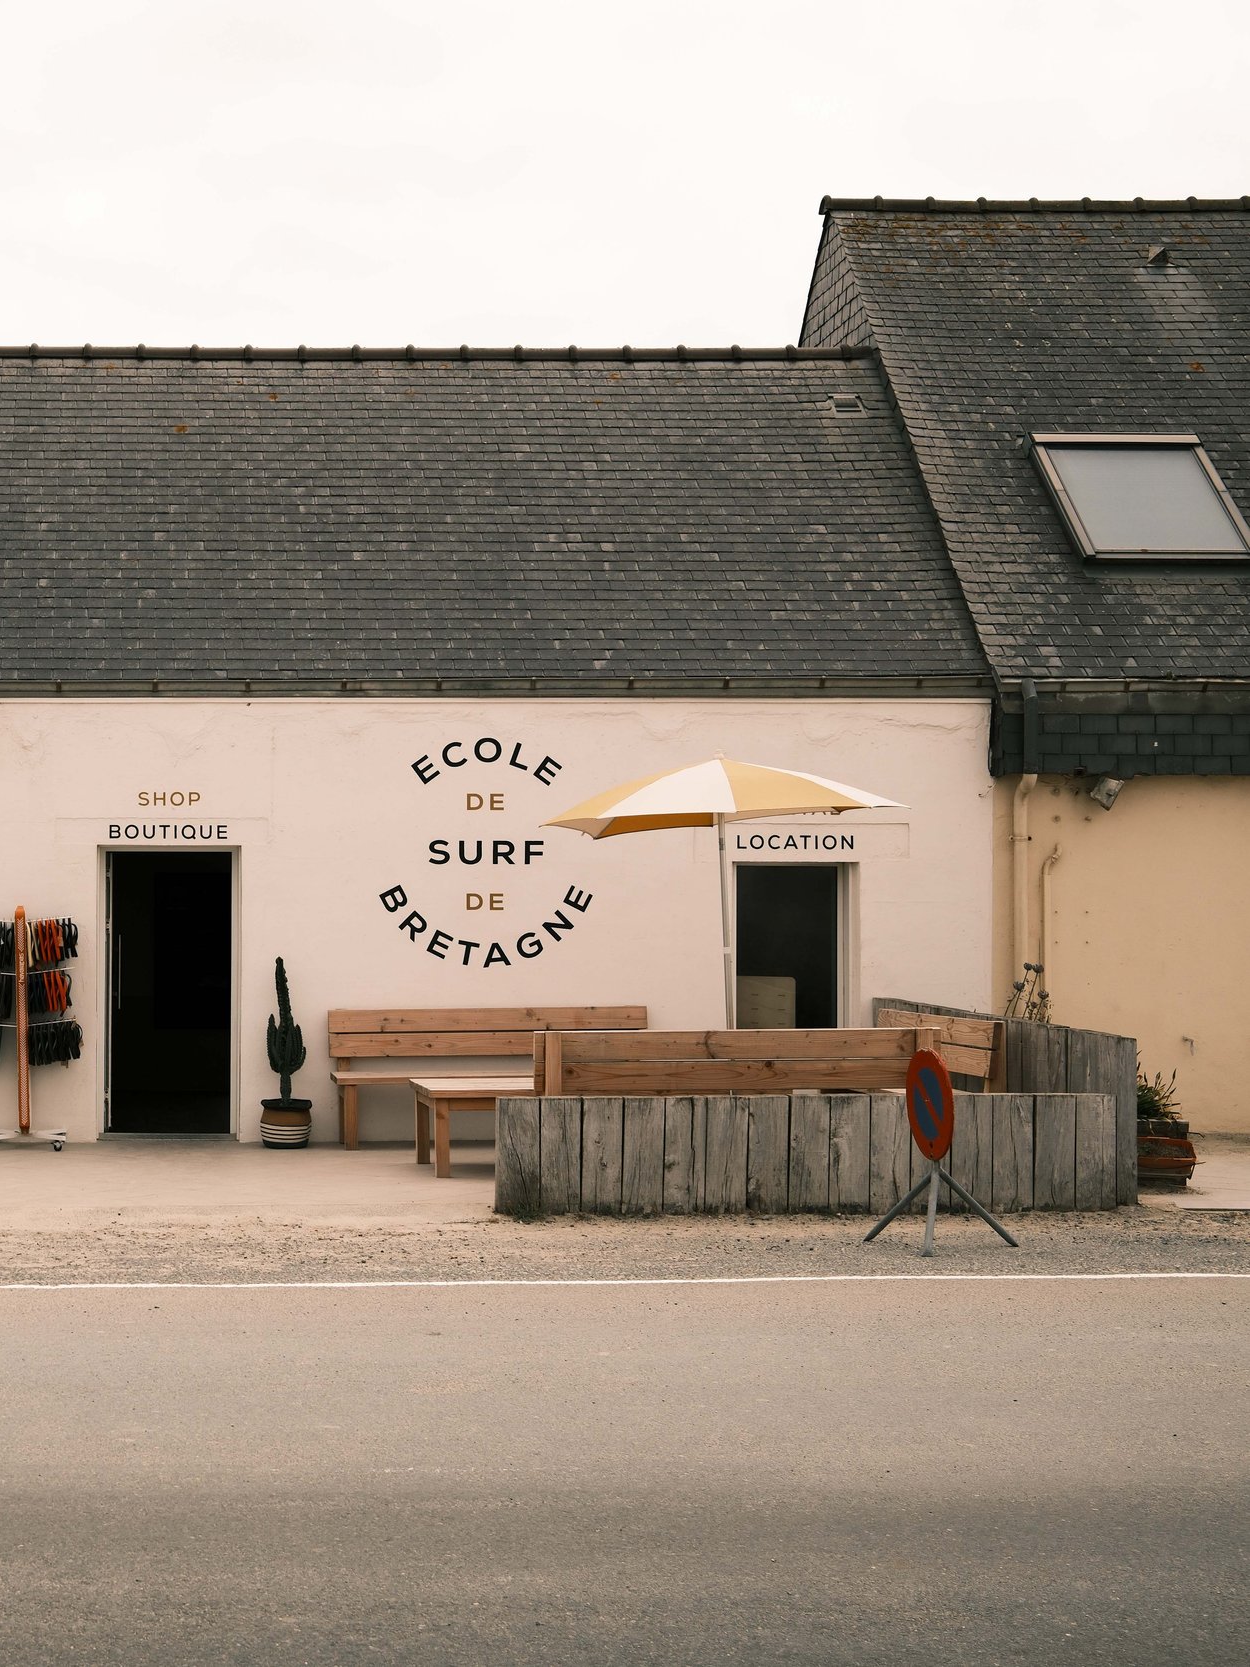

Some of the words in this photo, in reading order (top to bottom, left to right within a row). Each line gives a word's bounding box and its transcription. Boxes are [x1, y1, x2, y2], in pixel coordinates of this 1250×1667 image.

[411, 737, 562, 786] ECOLE
[138, 791, 201, 806] SHOP
[466, 793, 505, 810] DE
[109, 824, 228, 840] BOUTIQUE
[736, 835, 854, 850] LOCATION
[428, 839, 544, 865] SURF
[466, 893, 505, 910] DE
[379, 884, 593, 968] BRETAGNE
